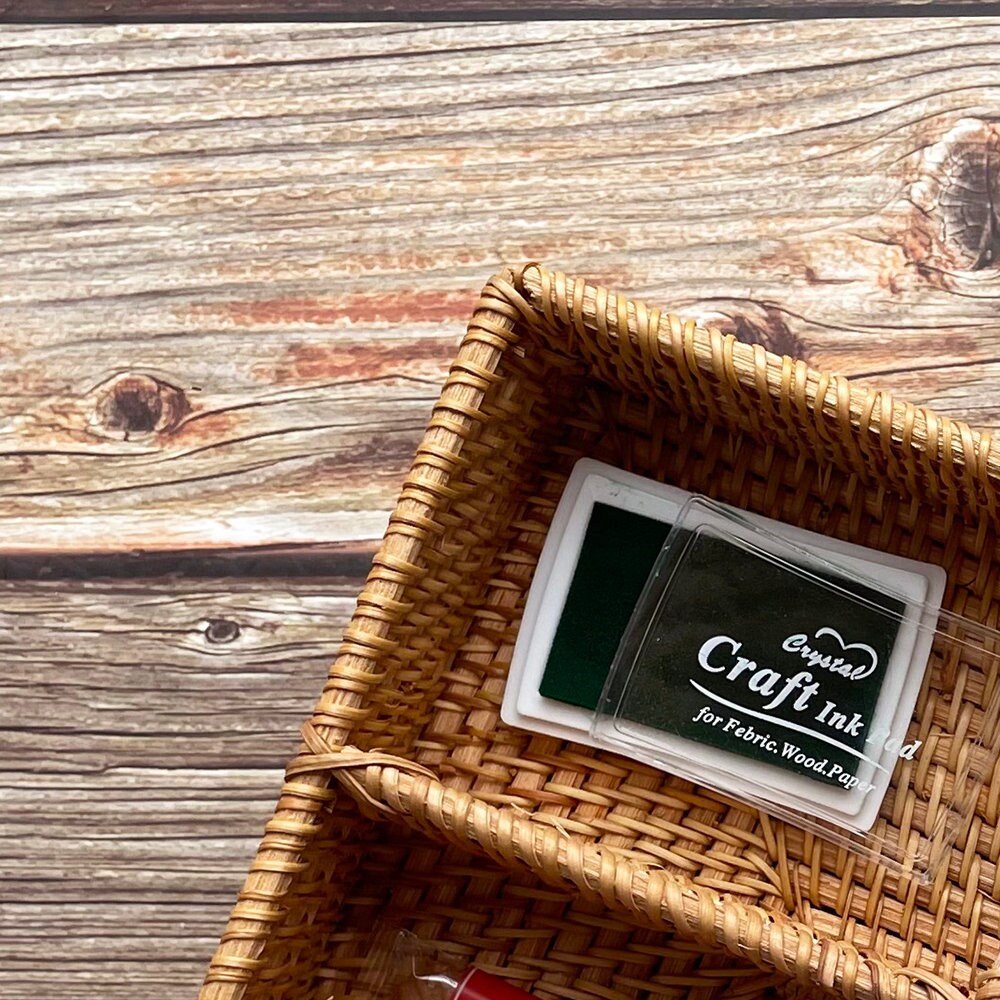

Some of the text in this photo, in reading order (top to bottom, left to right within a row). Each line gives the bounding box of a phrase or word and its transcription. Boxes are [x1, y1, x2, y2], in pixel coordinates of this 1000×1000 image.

[781, 633, 868, 681] Crystal
[697, 635, 819, 711] Craft
[814, 700, 865, 737] Ink
[692, 706, 723, 727] for
